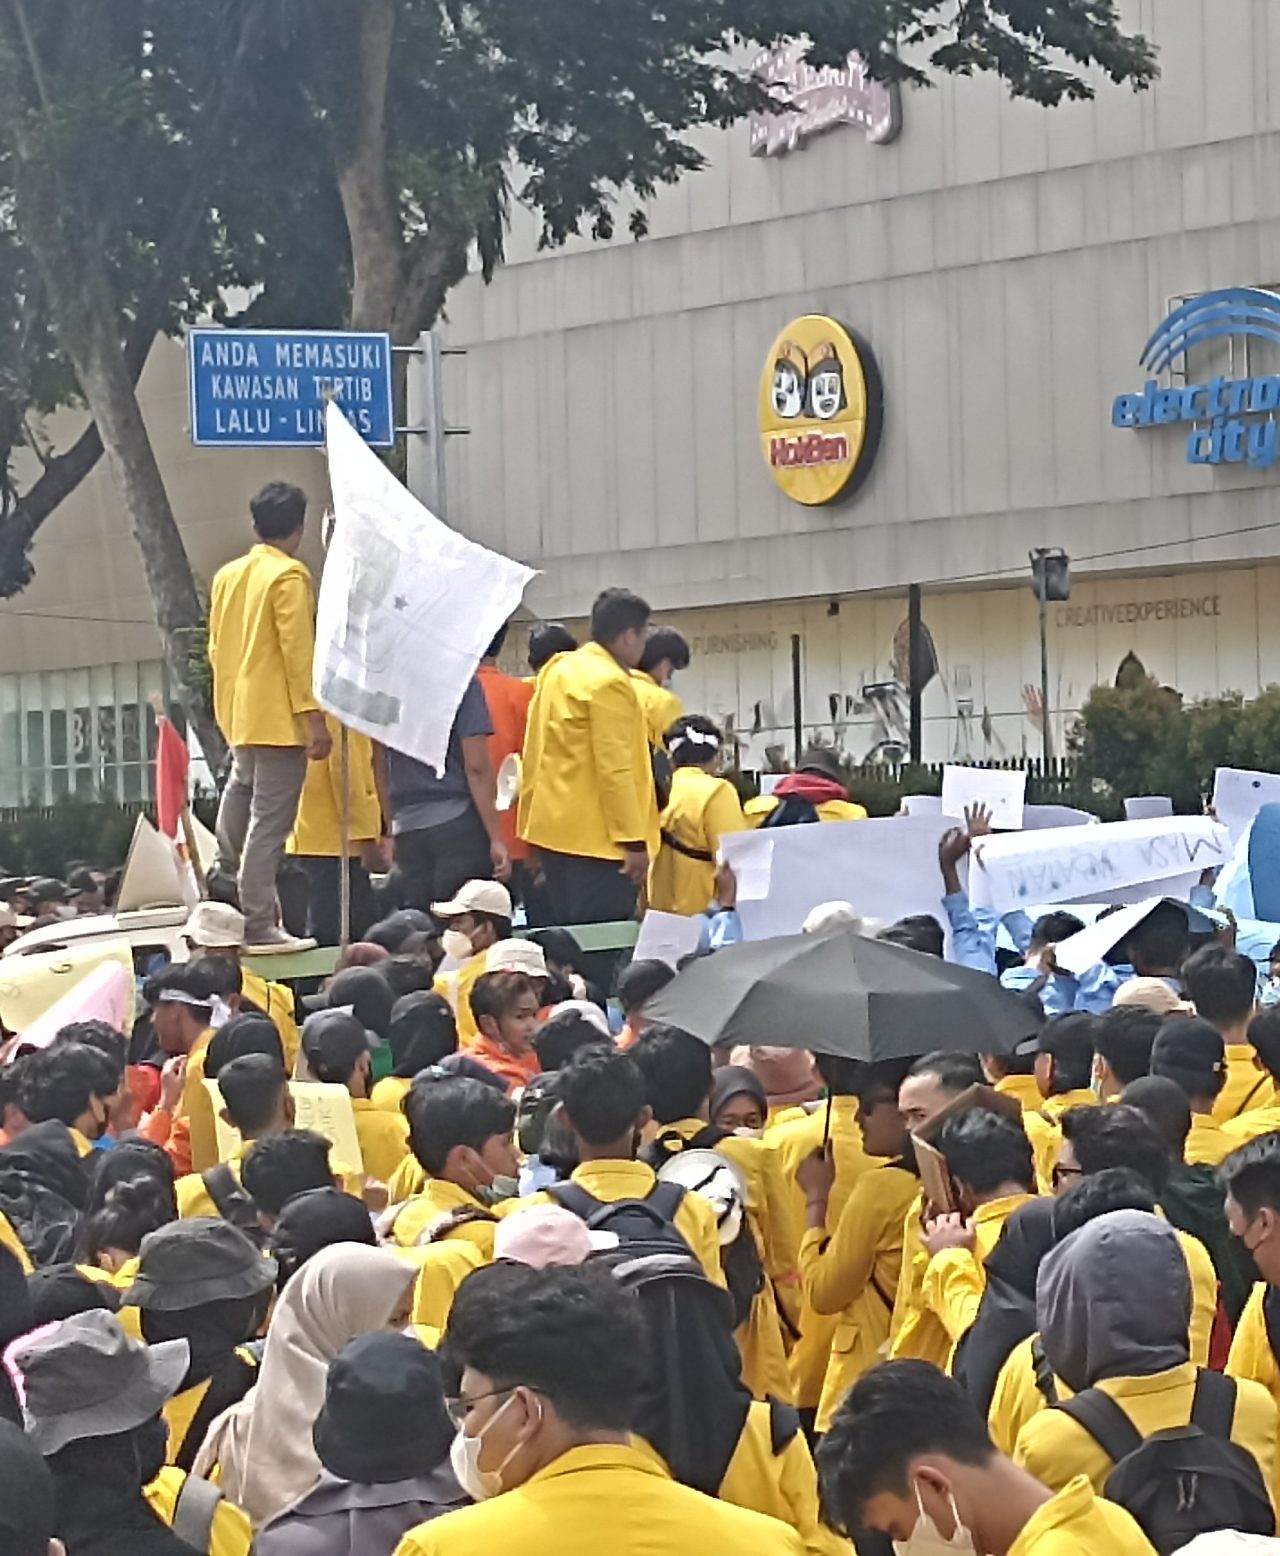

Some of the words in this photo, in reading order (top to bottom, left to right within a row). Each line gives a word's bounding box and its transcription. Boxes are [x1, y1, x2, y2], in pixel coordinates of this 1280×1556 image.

[201, 341, 259, 366] ANDA
[276, 343, 380, 369] MEMASUKI
[212, 373, 298, 400] KAWASAN
[216, 408, 270, 434] LALU
[297, 409, 371, 434] LINAS
[771, 434, 847, 466] HokBen
[1187, 416, 1279, 469] city
